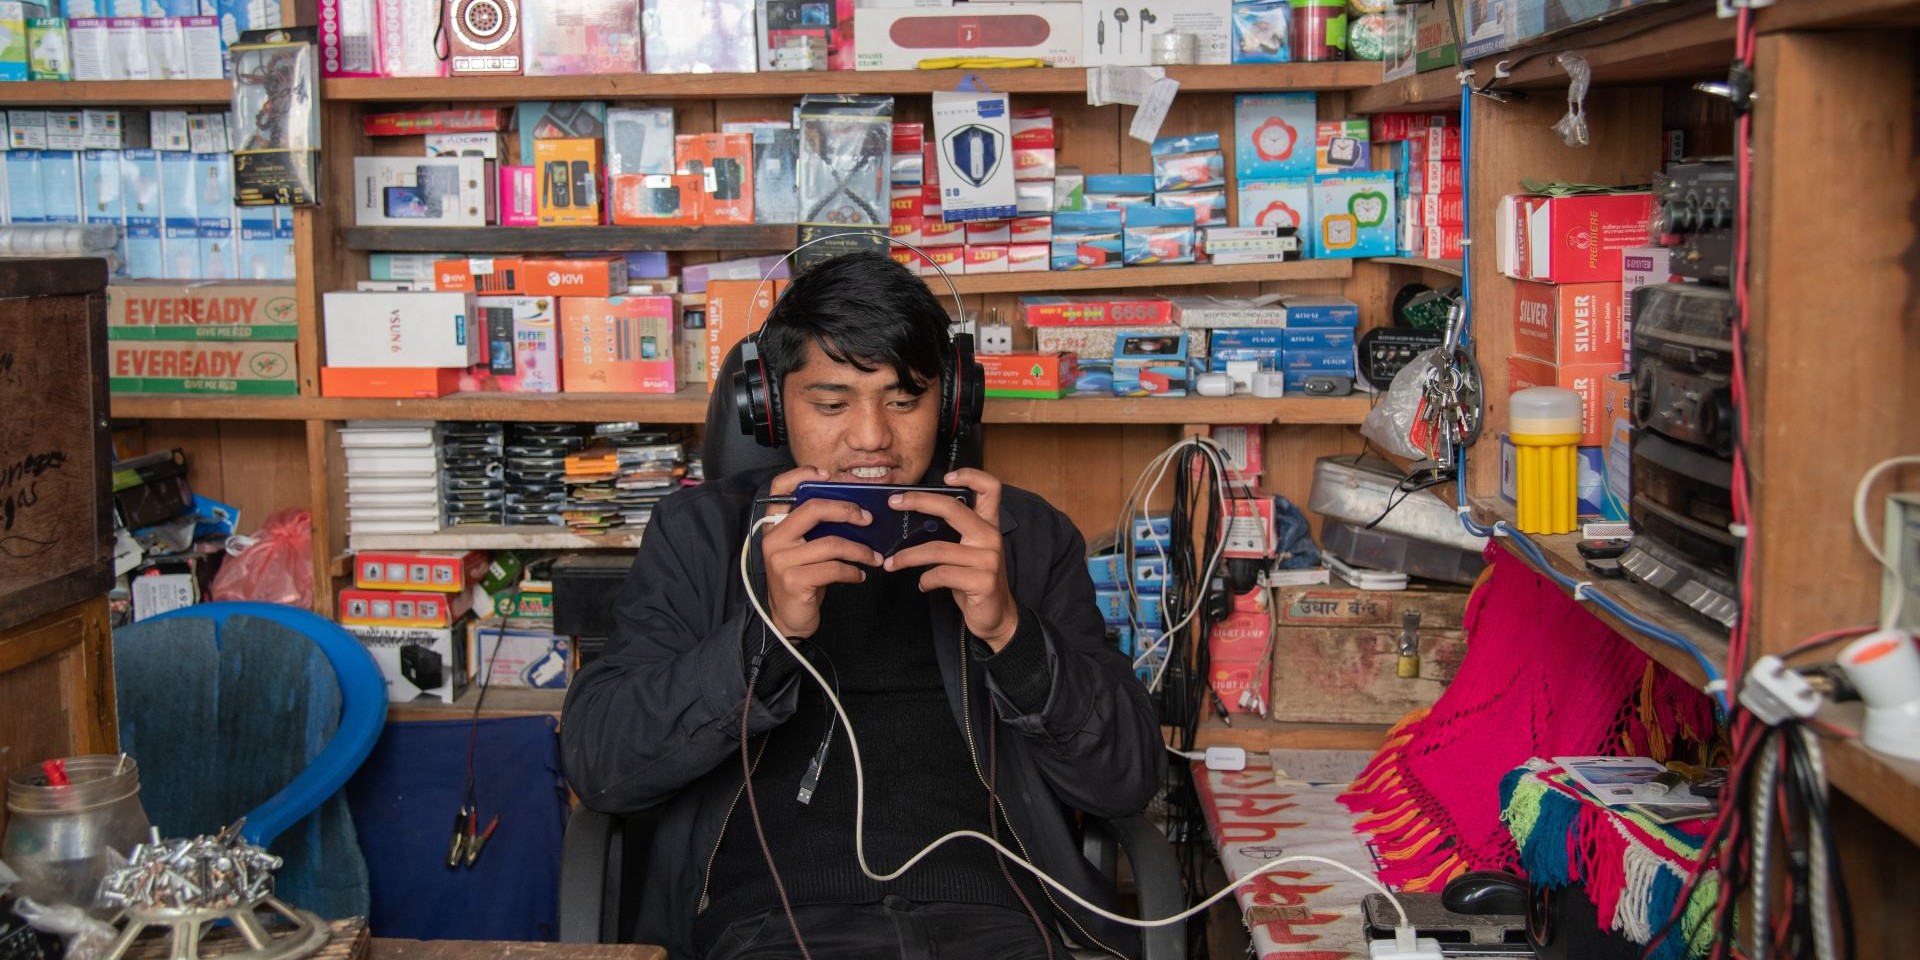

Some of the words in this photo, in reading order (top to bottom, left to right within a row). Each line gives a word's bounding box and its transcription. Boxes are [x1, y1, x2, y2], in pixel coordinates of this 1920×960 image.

[1431, 129, 1439, 147] SKP
[1430, 164, 1439, 181] SKP
[1427, 198, 1435, 216] SKP
[1430, 229, 1438, 247] SKP
[1589, 210, 1599, 269] PREMIERE
[974, 251, 998, 261] NEXT
[561, 274, 584, 285] KIVI
[125, 297, 258, 325] EVEREADY
[709, 297, 720, 326] Talk
[1520, 300, 1548, 329] SILVER
[196, 327, 216, 337] GIVE
[217, 327, 231, 336] ME
[232, 327, 252, 337] RED
[390, 309, 401, 342] VSUN
[1574, 295, 1590, 352] SILVER
[710, 329, 720, 342] In
[391, 345, 402, 353] 6
[116, 350, 244, 378] EVEREADY
[710, 345, 721, 380] Style
[184, 379, 203, 389] GIVE
[204, 380, 218, 389] ME
[218, 380, 237, 391] RED
[1297, 600, 1338, 615] उधार
[1213, 629, 1238, 638] LIGHT
[1240, 629, 1264, 638] LAMP
[1212, 680, 1238, 689] LIGHT
